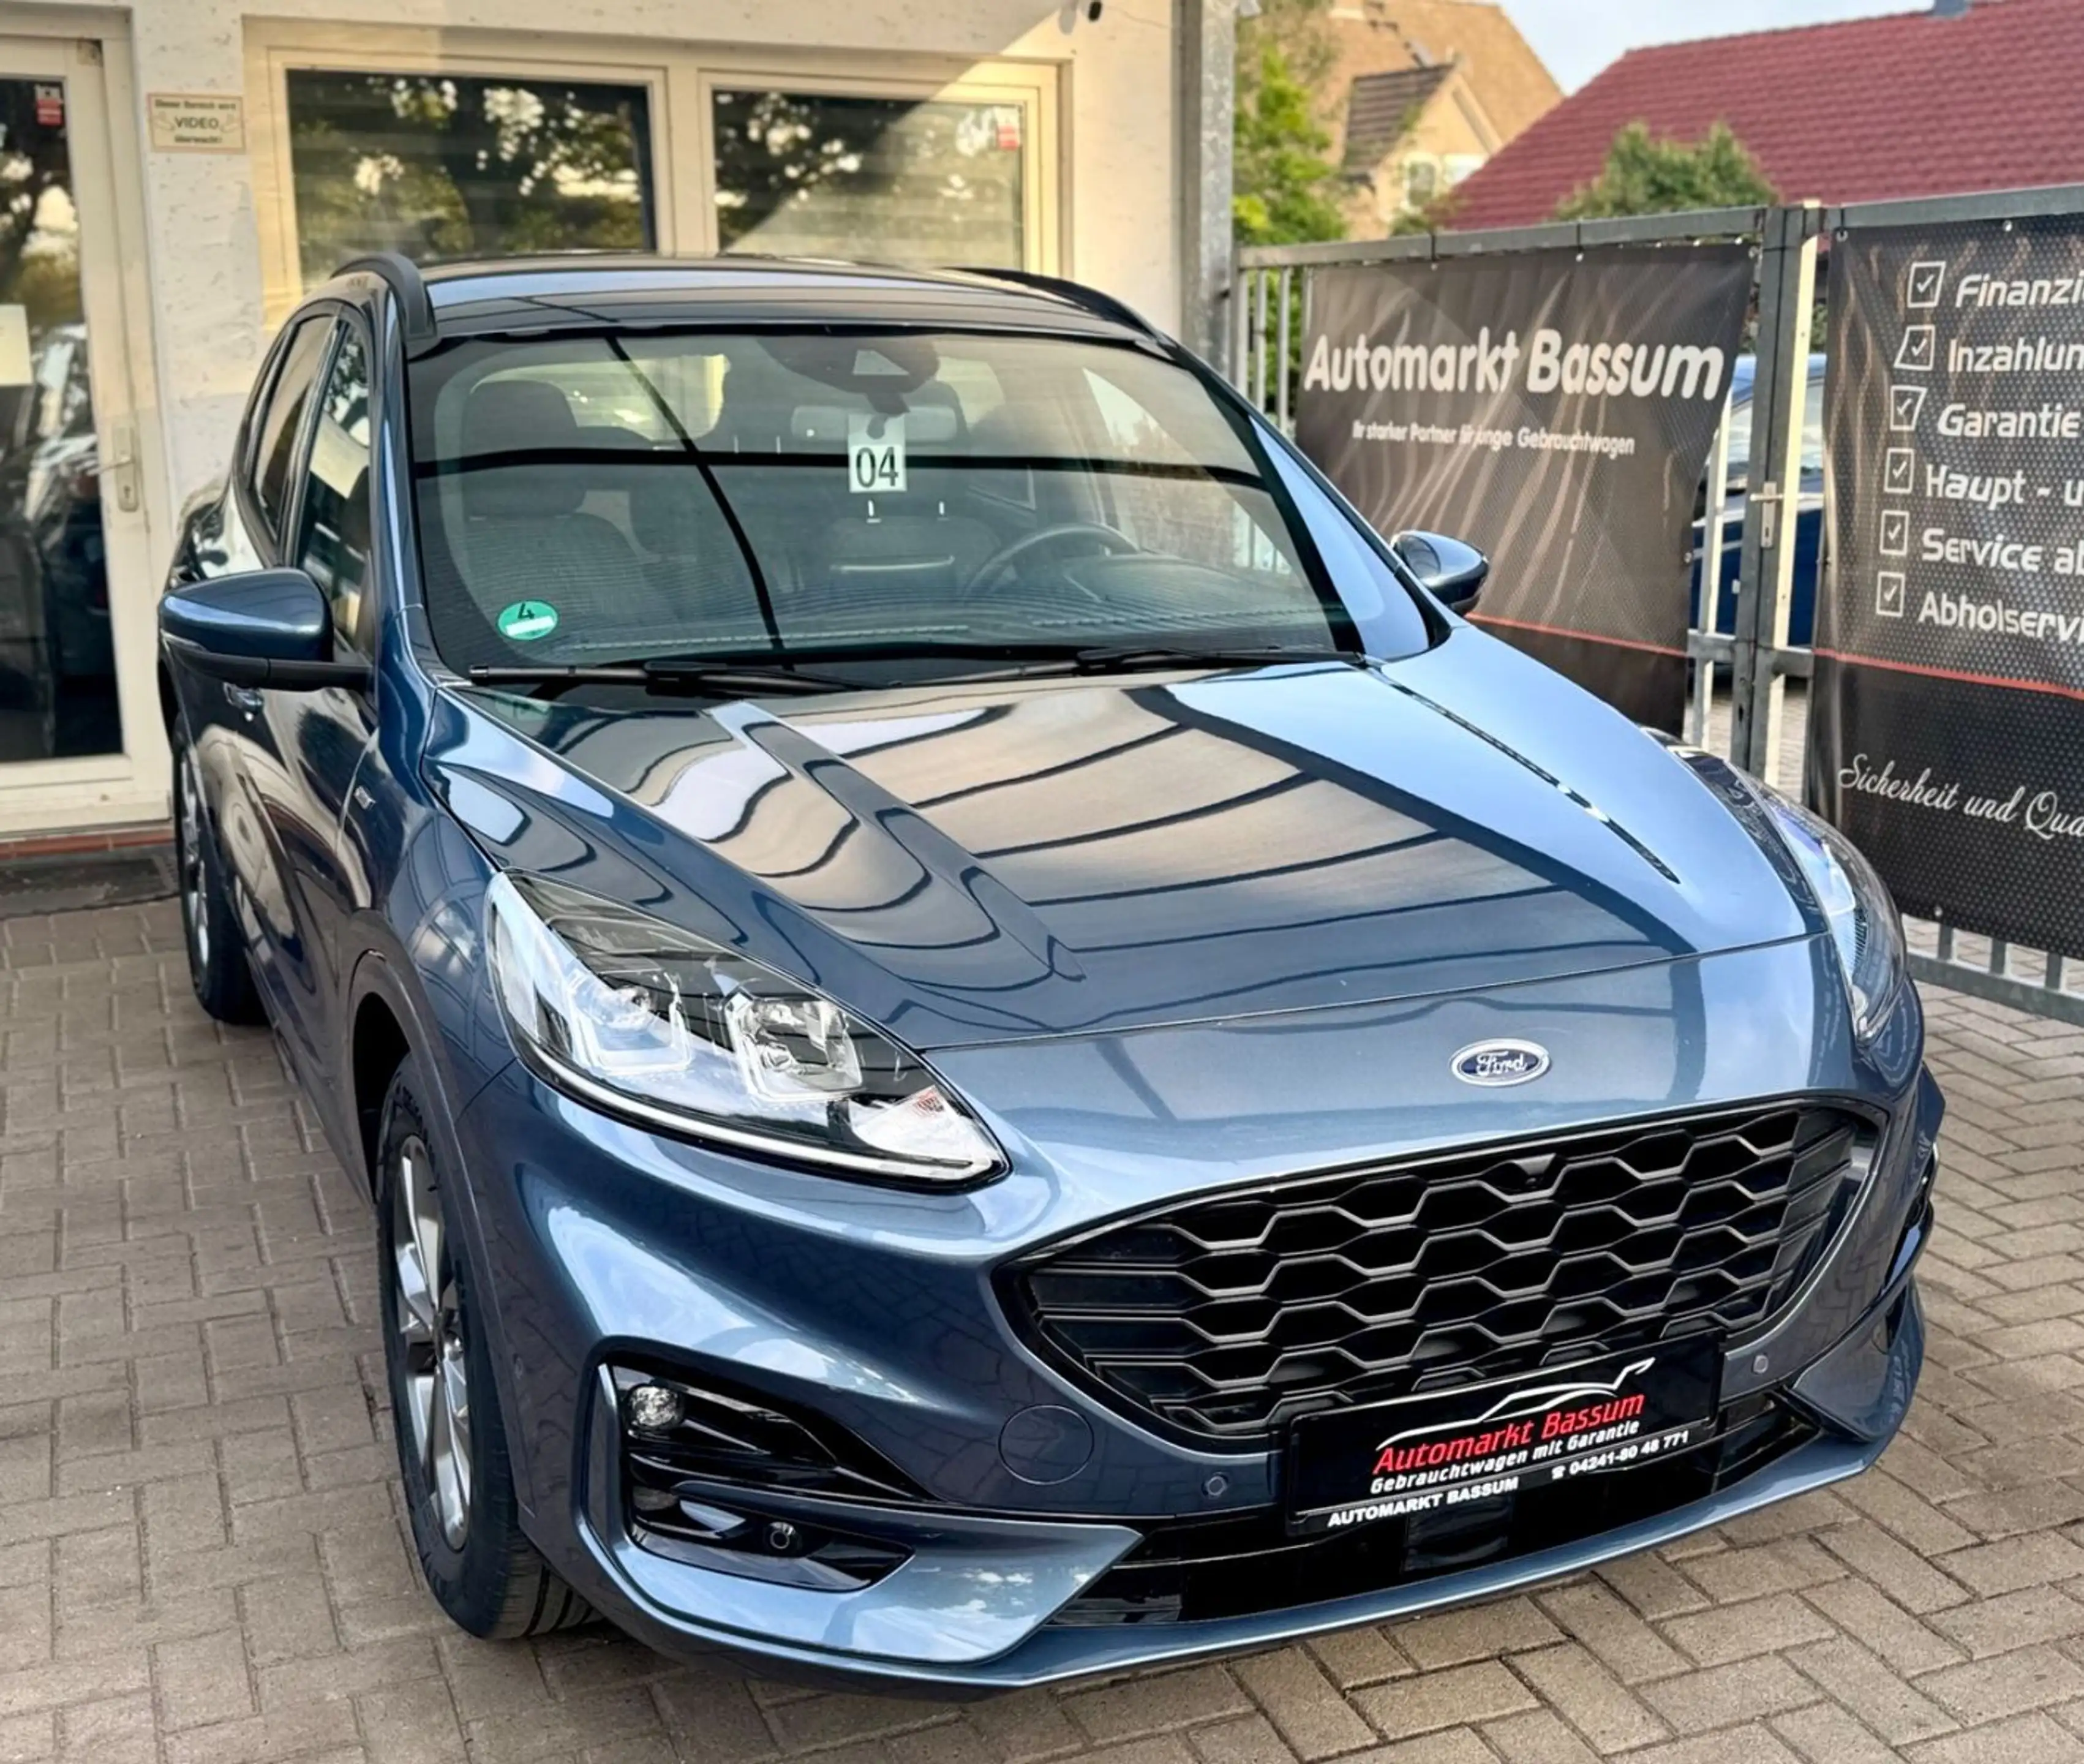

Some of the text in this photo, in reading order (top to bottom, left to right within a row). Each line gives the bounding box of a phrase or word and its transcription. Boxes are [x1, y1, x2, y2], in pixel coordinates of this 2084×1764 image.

[174, 116, 219, 130] VIDEO
[1956, 270, 2084, 307] Finanzi
[1304, 326, 1724, 401] Automarkt Bassum
[1948, 335, 2084, 372] Inzahlun
[1938, 402, 2081, 438] Garantie
[1410, 422, 1457, 444] Partner
[1517, 426, 1635, 460] Gebrauchtwagen
[856, 447, 898, 488] 04
[1925, 464, 2026, 510] Haupt
[1922, 527, 2043, 573] Service
[517, 602, 535, 619] 4
[1838, 753, 1959, 810] Sicherheit
[1963, 786, 2026, 823] und
[1475, 1050, 1528, 1077] Ford
[1372, 1393, 1646, 1475] Automarkt Bassum
[1371, 1420, 1640, 1495] Gebrauchtwagen mit Garantie
[1326, 1494, 1443, 1528] AUTOMARKT
[1446, 1476, 1519, 1505] BASSUM
[1663, 1430, 1689, 1449] 771
